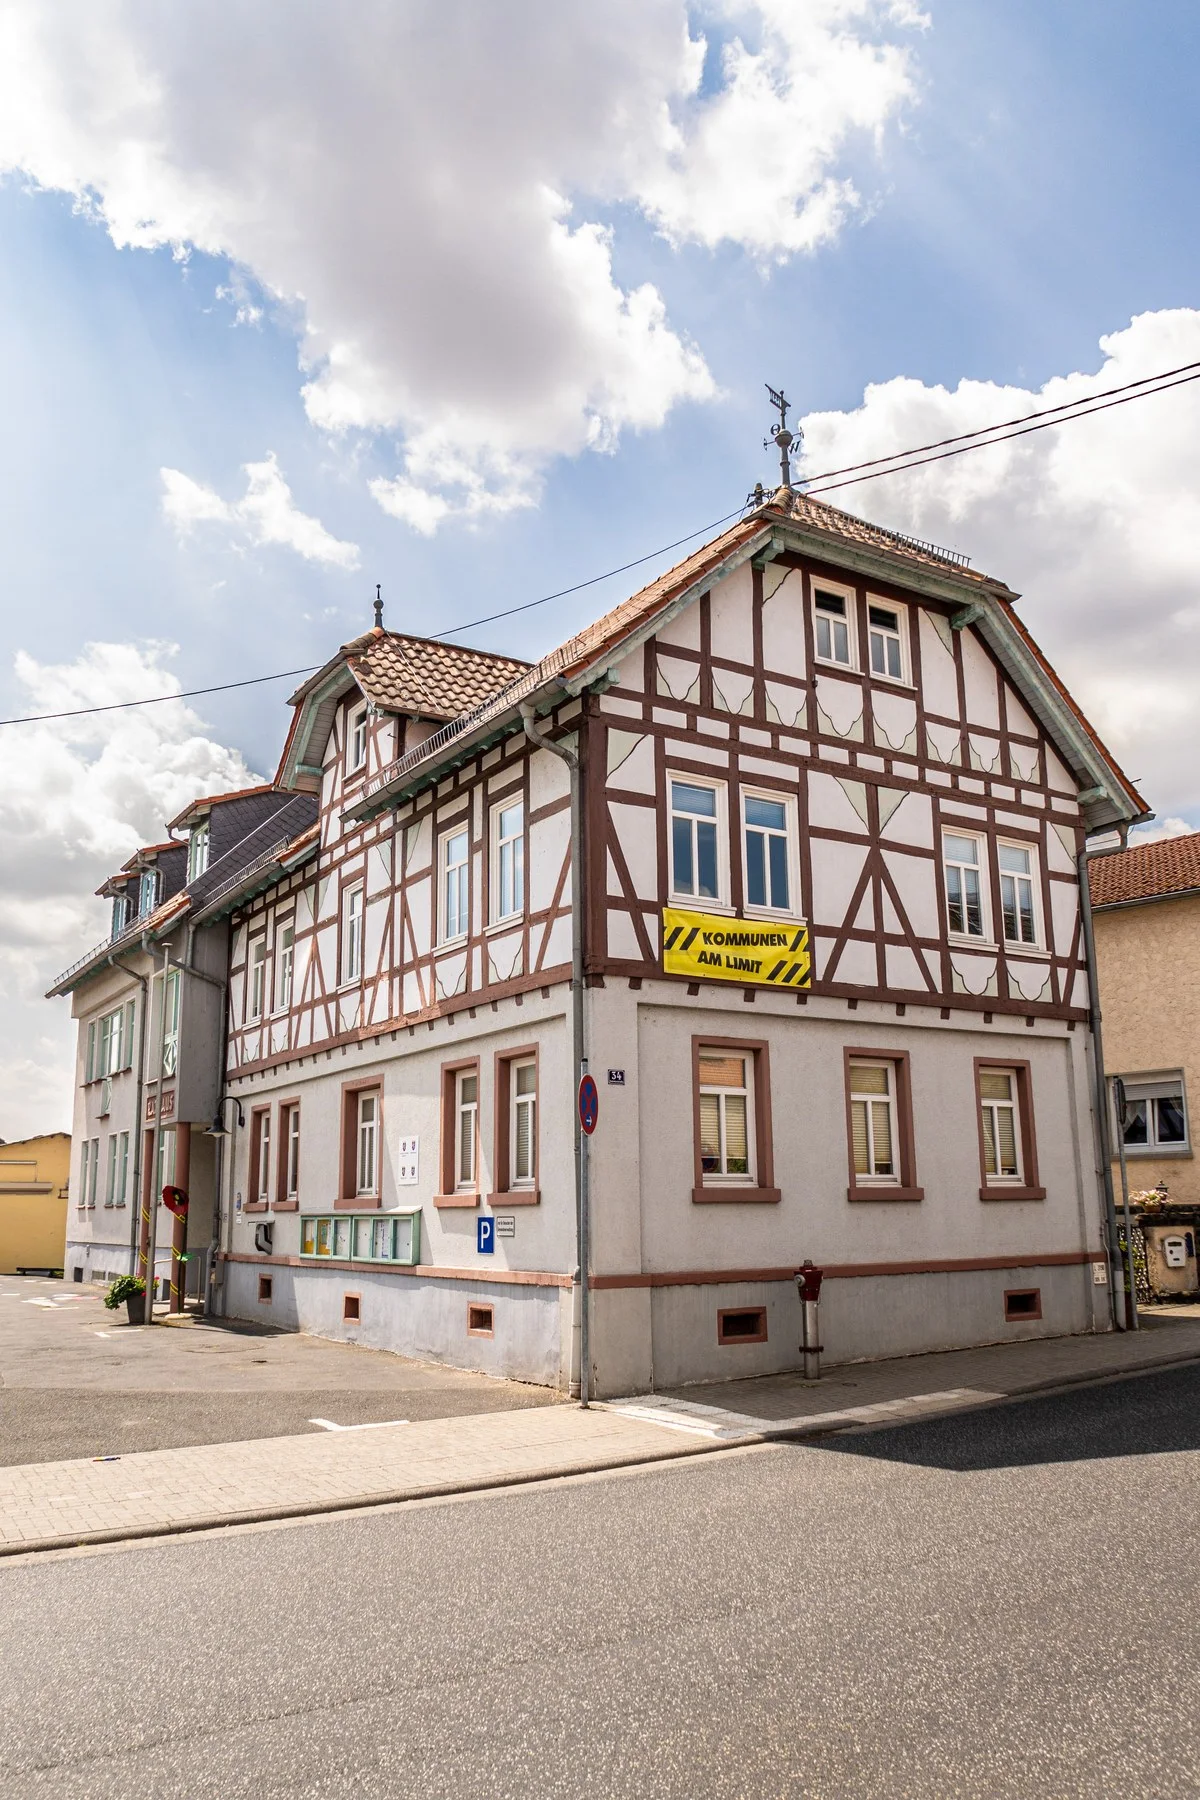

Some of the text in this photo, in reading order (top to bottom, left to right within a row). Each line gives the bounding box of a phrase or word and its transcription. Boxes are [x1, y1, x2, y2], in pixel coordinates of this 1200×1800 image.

[702, 932, 788, 947] KOMMUNEN
[697, 951, 763, 974] AM LIMIT
[611, 1071, 622, 1080] 34
[147, 1094, 174, 1117] RAAUS
[480, 1221, 490, 1249] P
